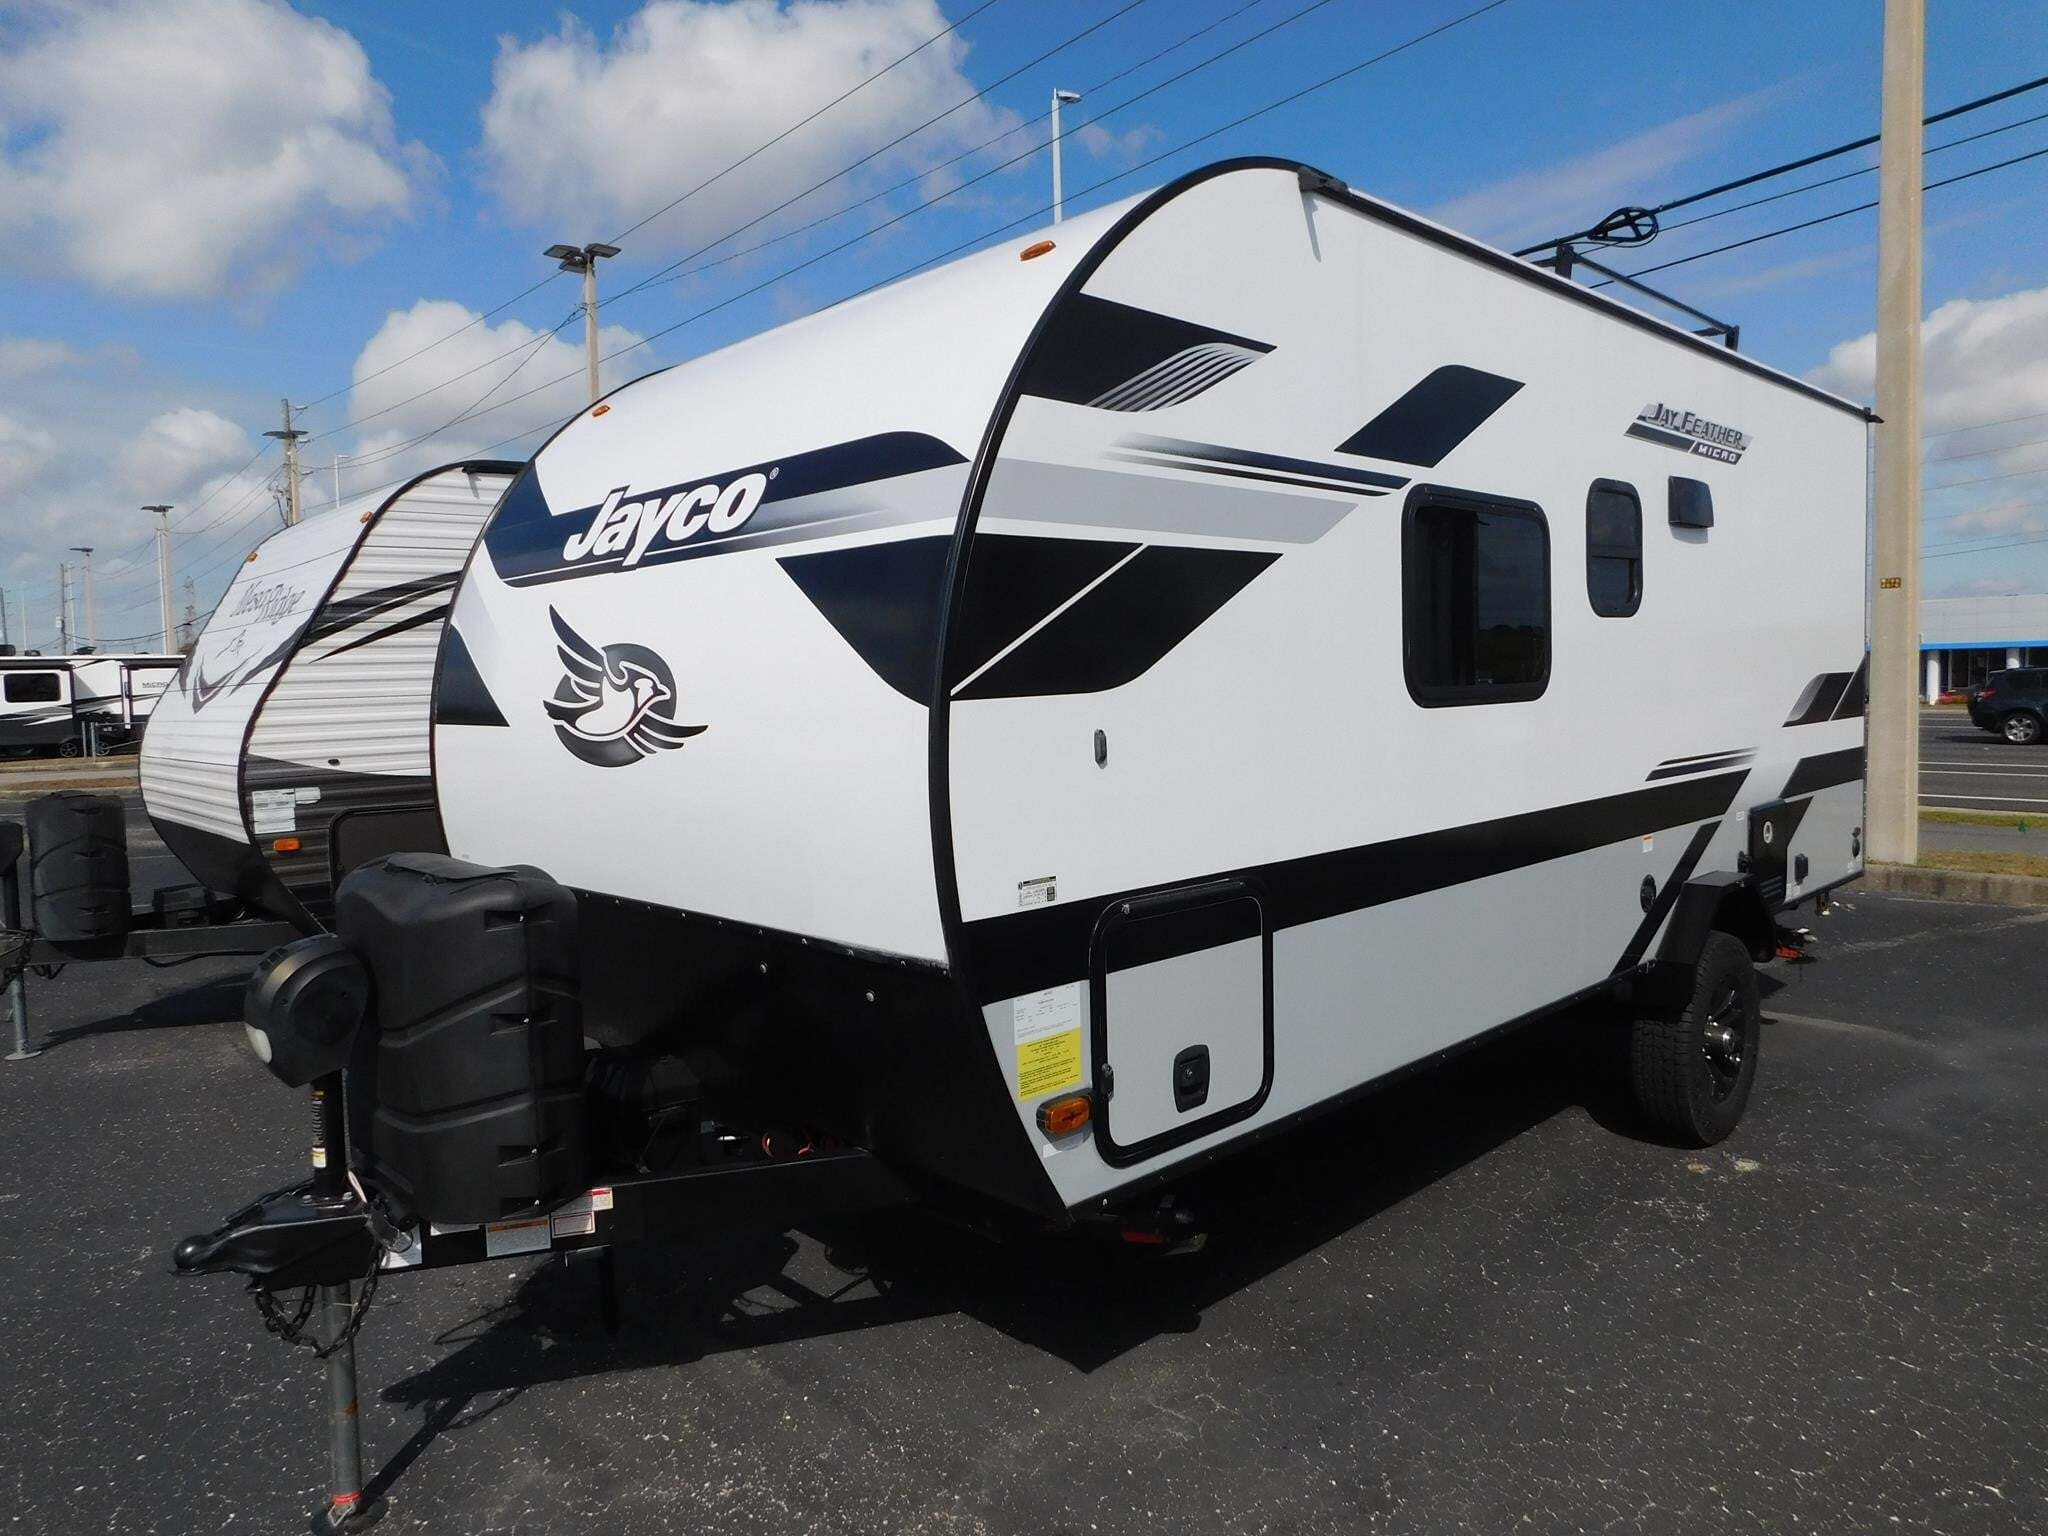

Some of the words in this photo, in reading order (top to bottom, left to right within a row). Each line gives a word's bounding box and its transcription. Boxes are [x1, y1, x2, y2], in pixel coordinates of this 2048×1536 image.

[1681, 411, 1743, 446] FEATHER
[1698, 444, 1737, 462] MICRO
[563, 473, 767, 567] Jayco
